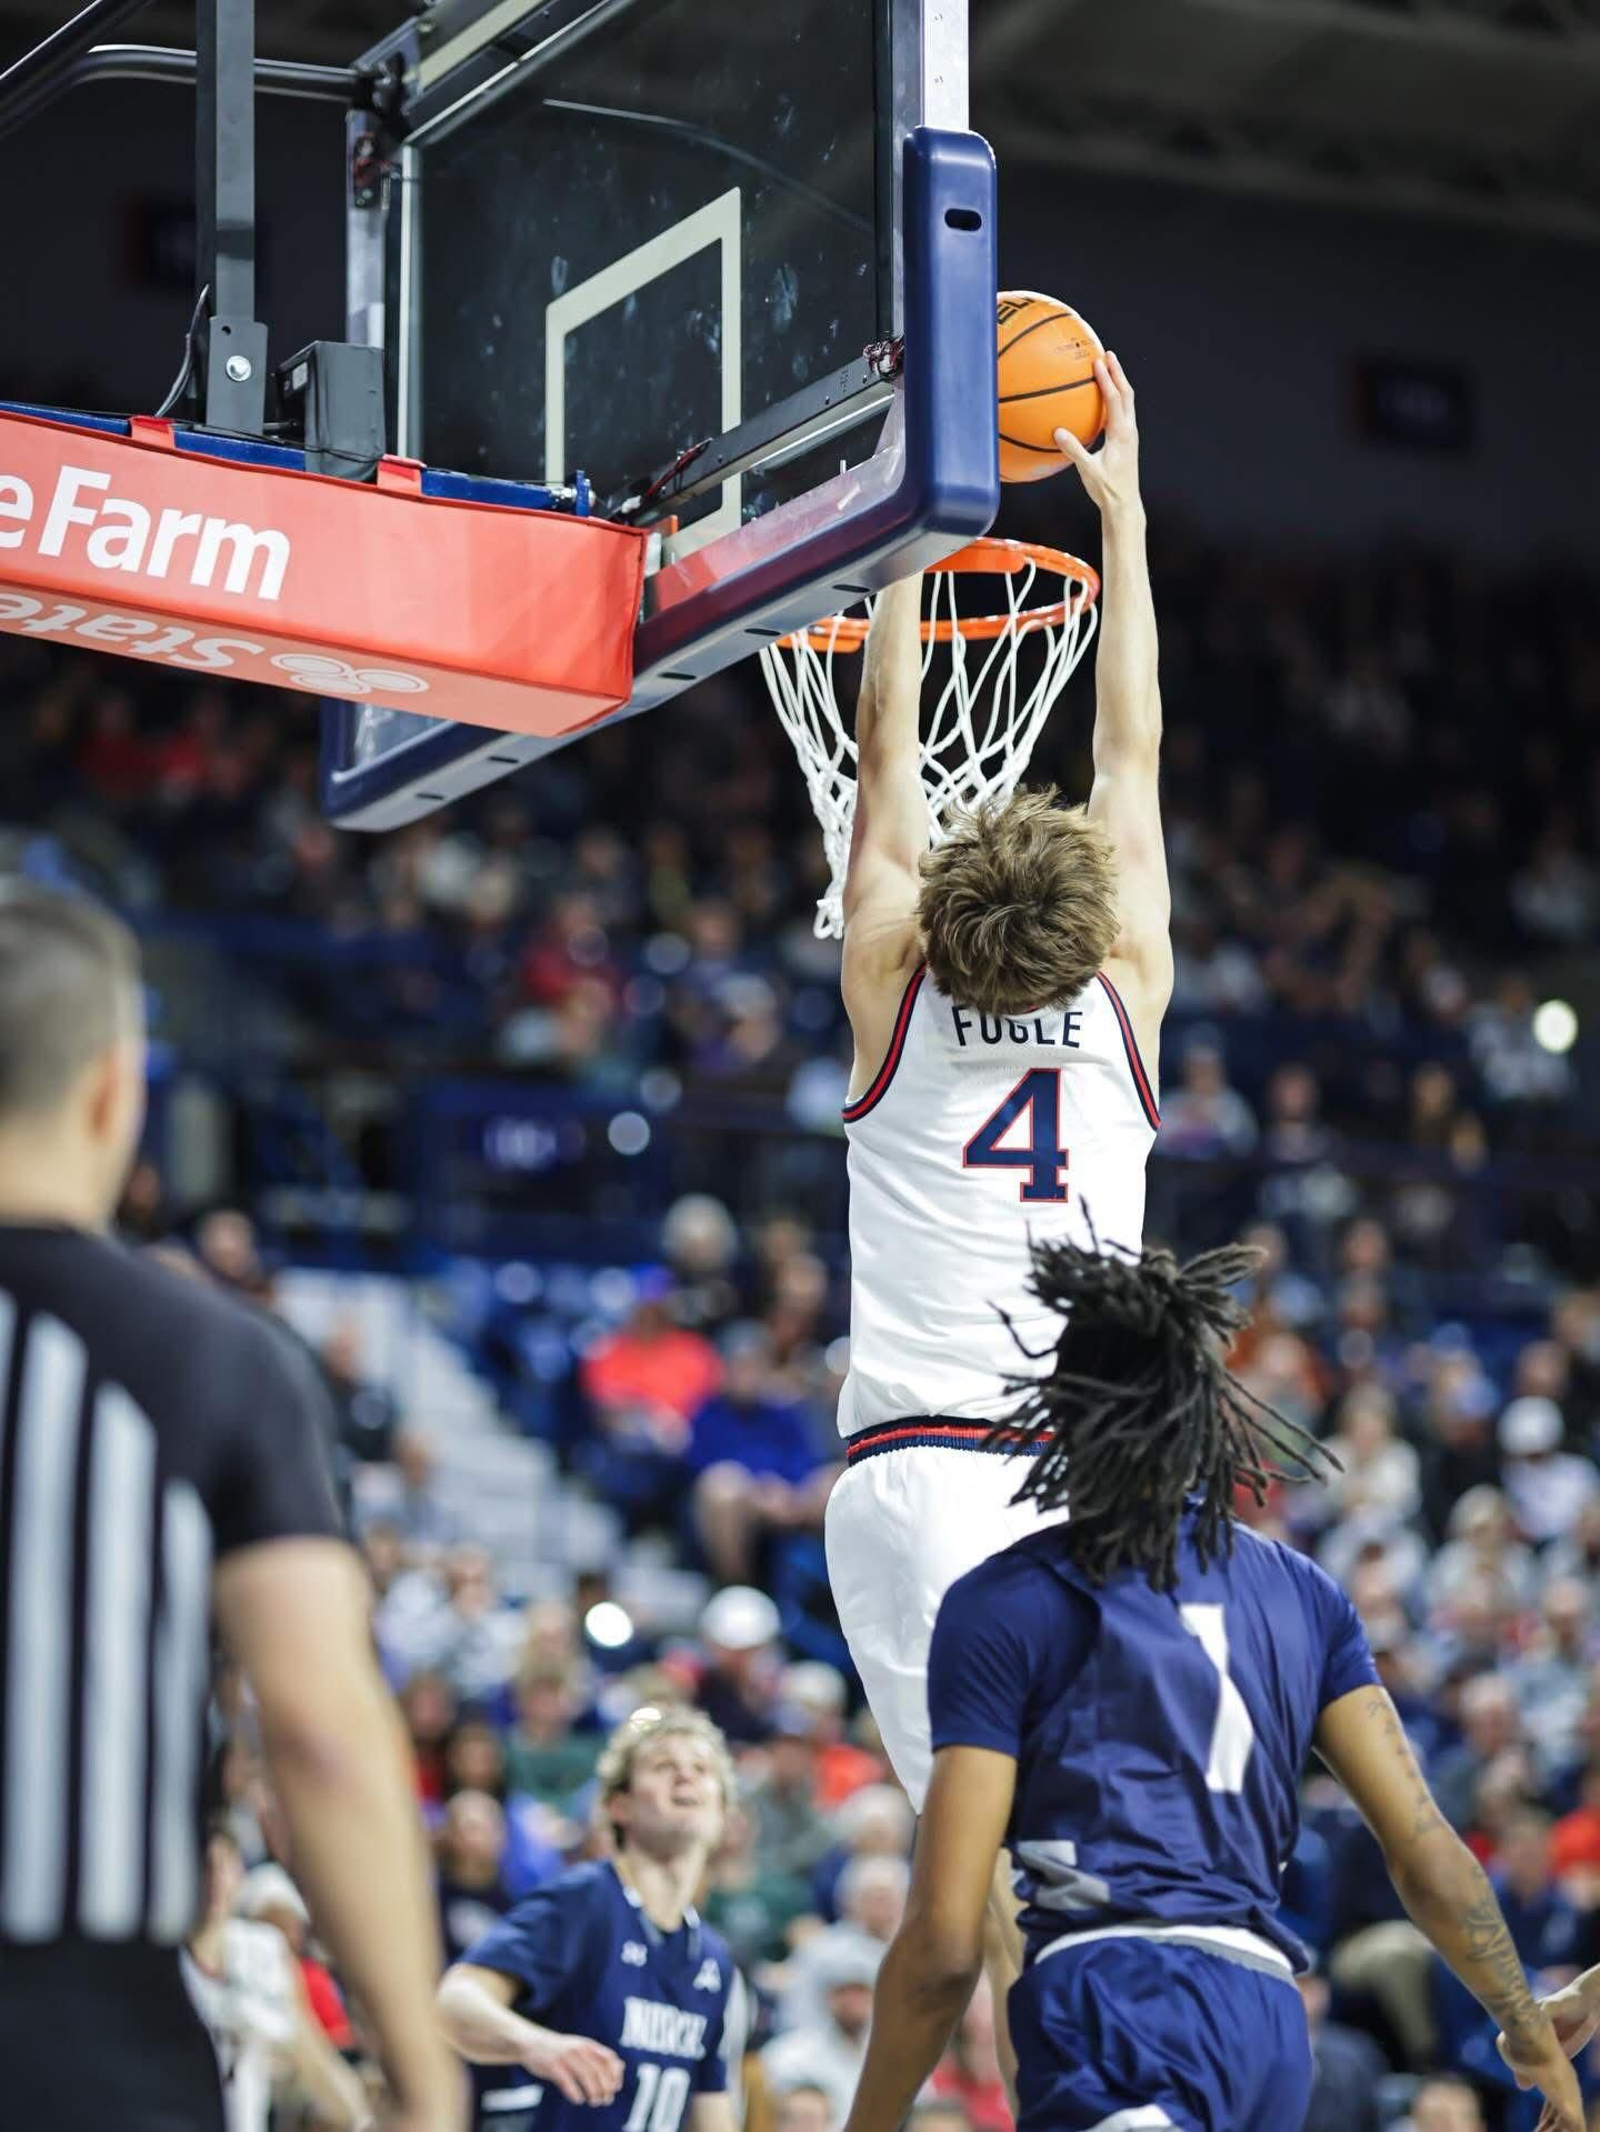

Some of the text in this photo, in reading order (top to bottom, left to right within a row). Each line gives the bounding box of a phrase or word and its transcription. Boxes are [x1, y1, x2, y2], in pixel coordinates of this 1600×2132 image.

[37, 465, 291, 601] Farm
[0, 593, 266, 668] State
[962, 1067, 1070, 1203] 4
[1180, 1603, 1255, 1796] 1
[622, 2062, 691, 2132] 10
